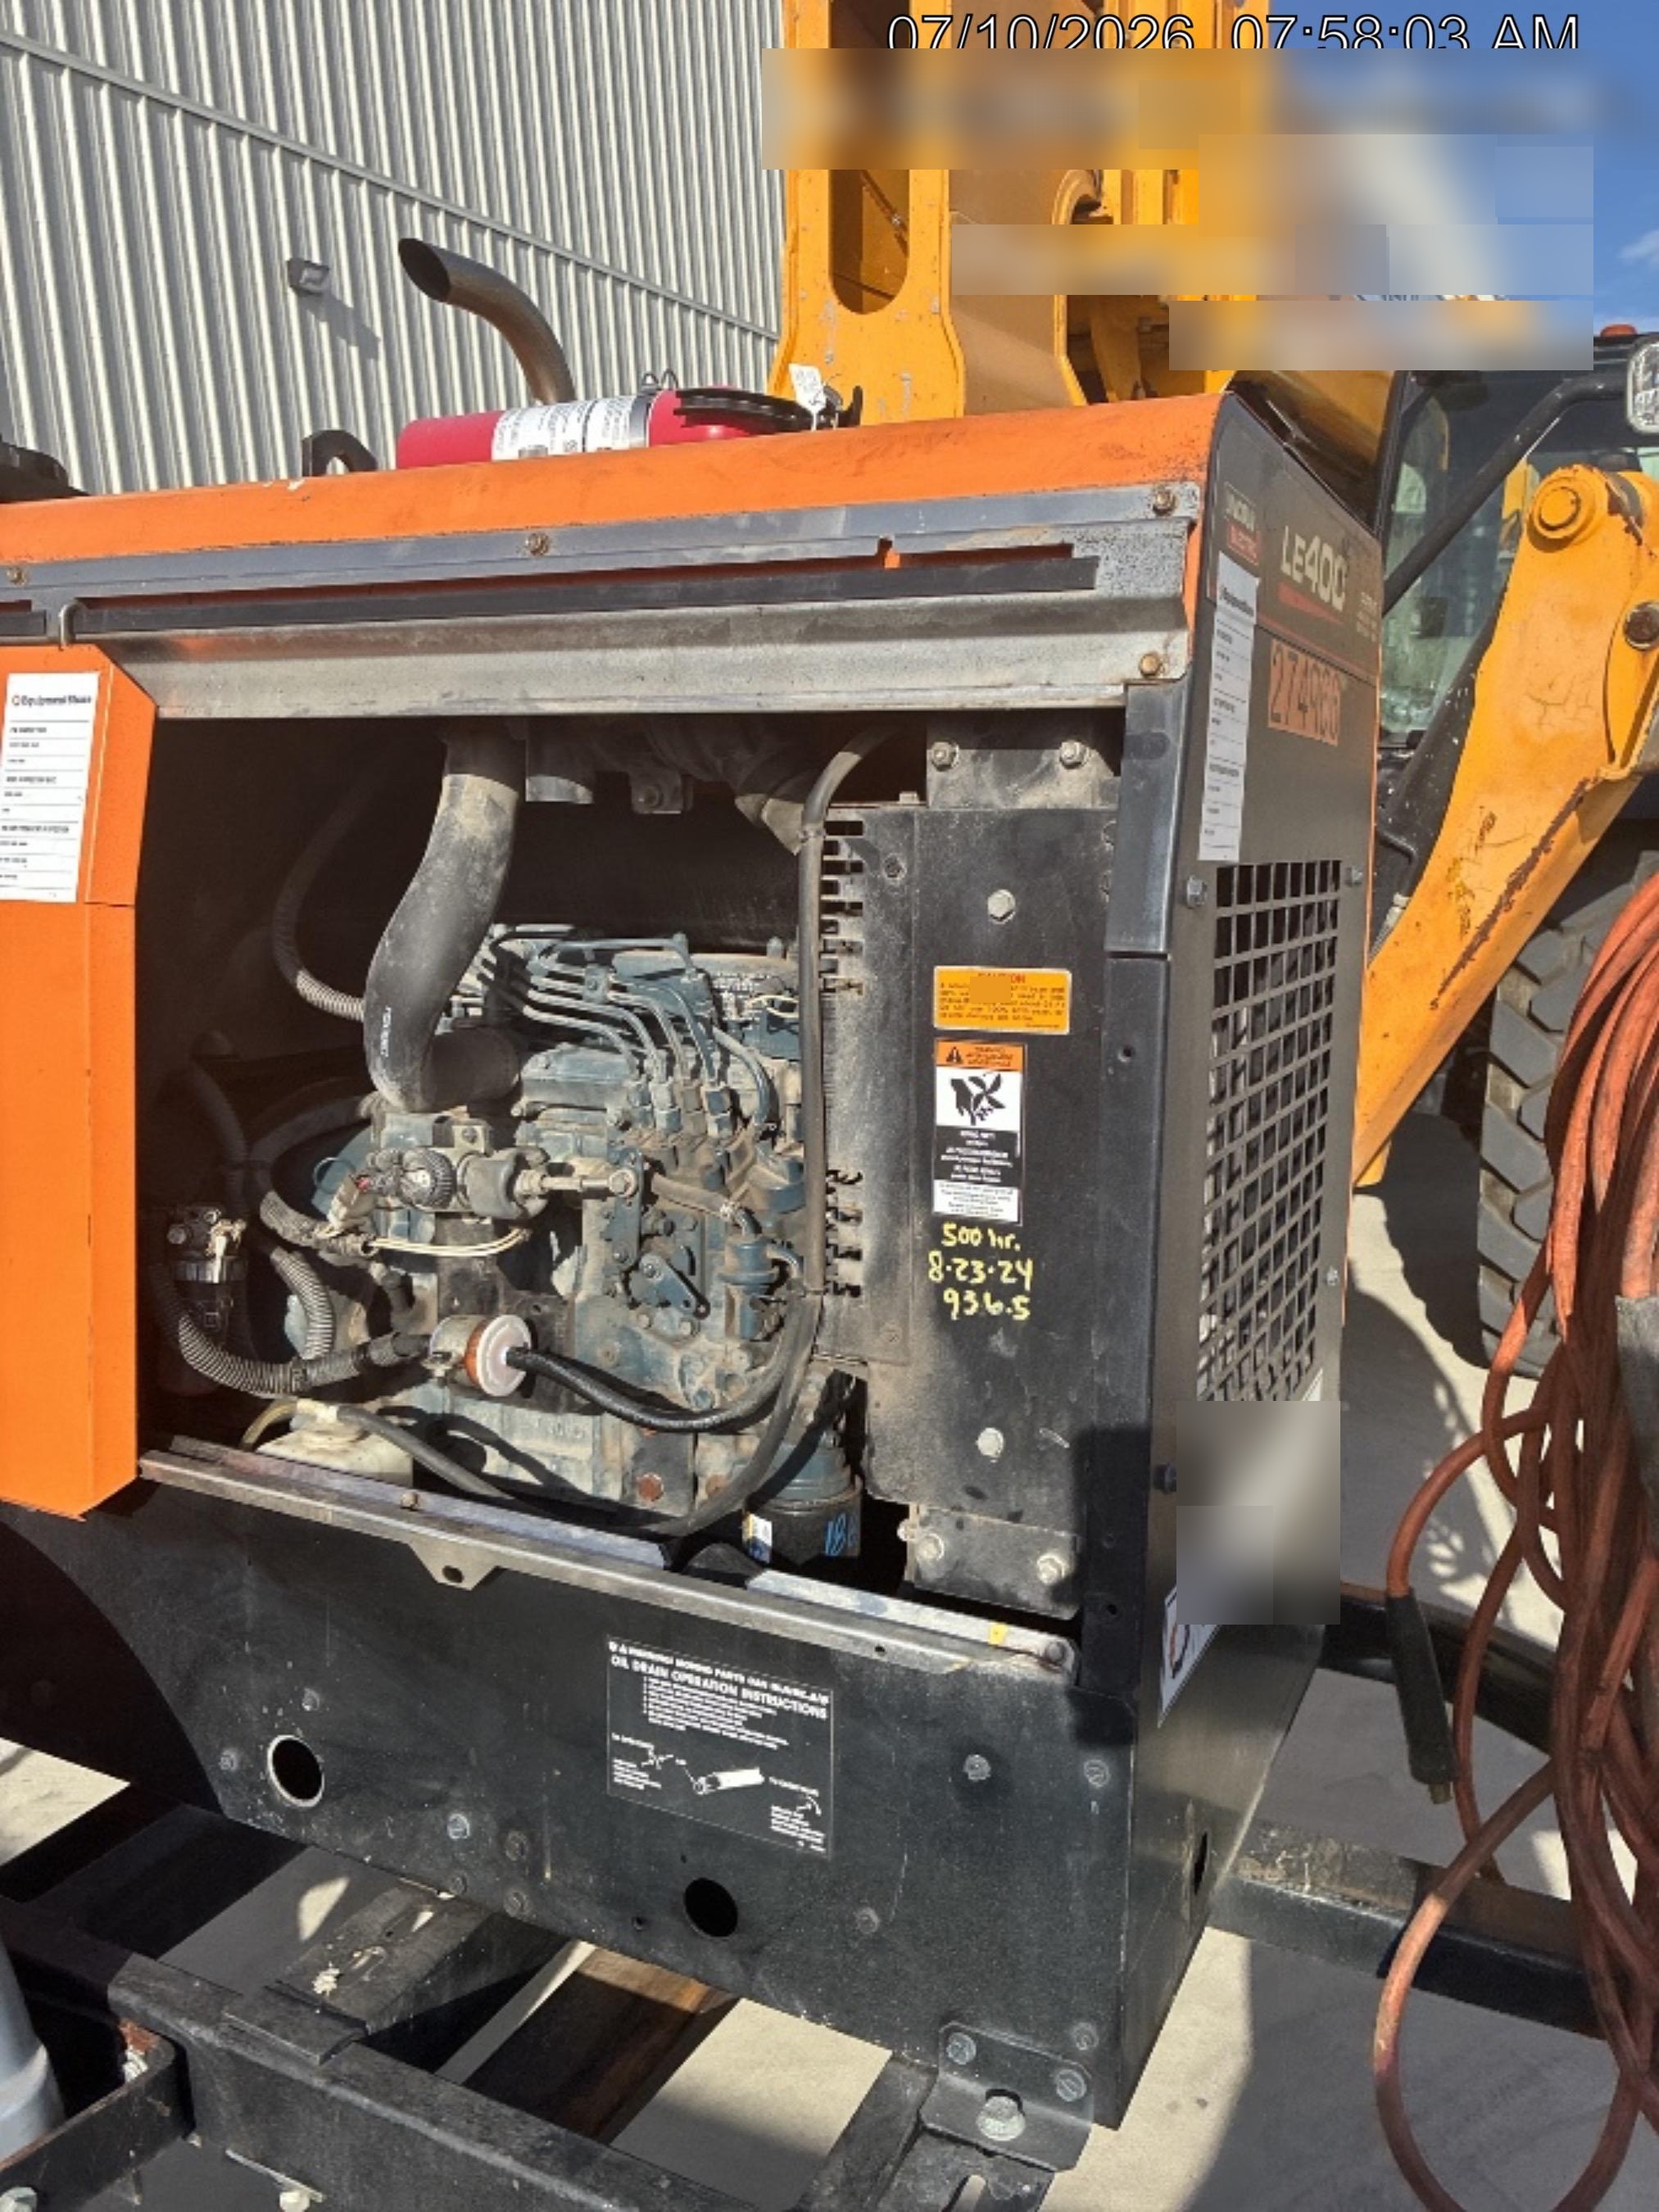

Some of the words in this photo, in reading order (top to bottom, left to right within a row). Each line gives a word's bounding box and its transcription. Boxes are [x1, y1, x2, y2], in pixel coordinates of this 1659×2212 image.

[941, 1222, 984, 1248] 500
[986, 1228, 1022, 1252] hr.
[943, 1287, 1031, 1322] 936.5
[611, 1655, 629, 1670] OIL
[671, 1670, 737, 1698] OPERATION
[741, 1687, 827, 1720] INSTRUCTIONS
